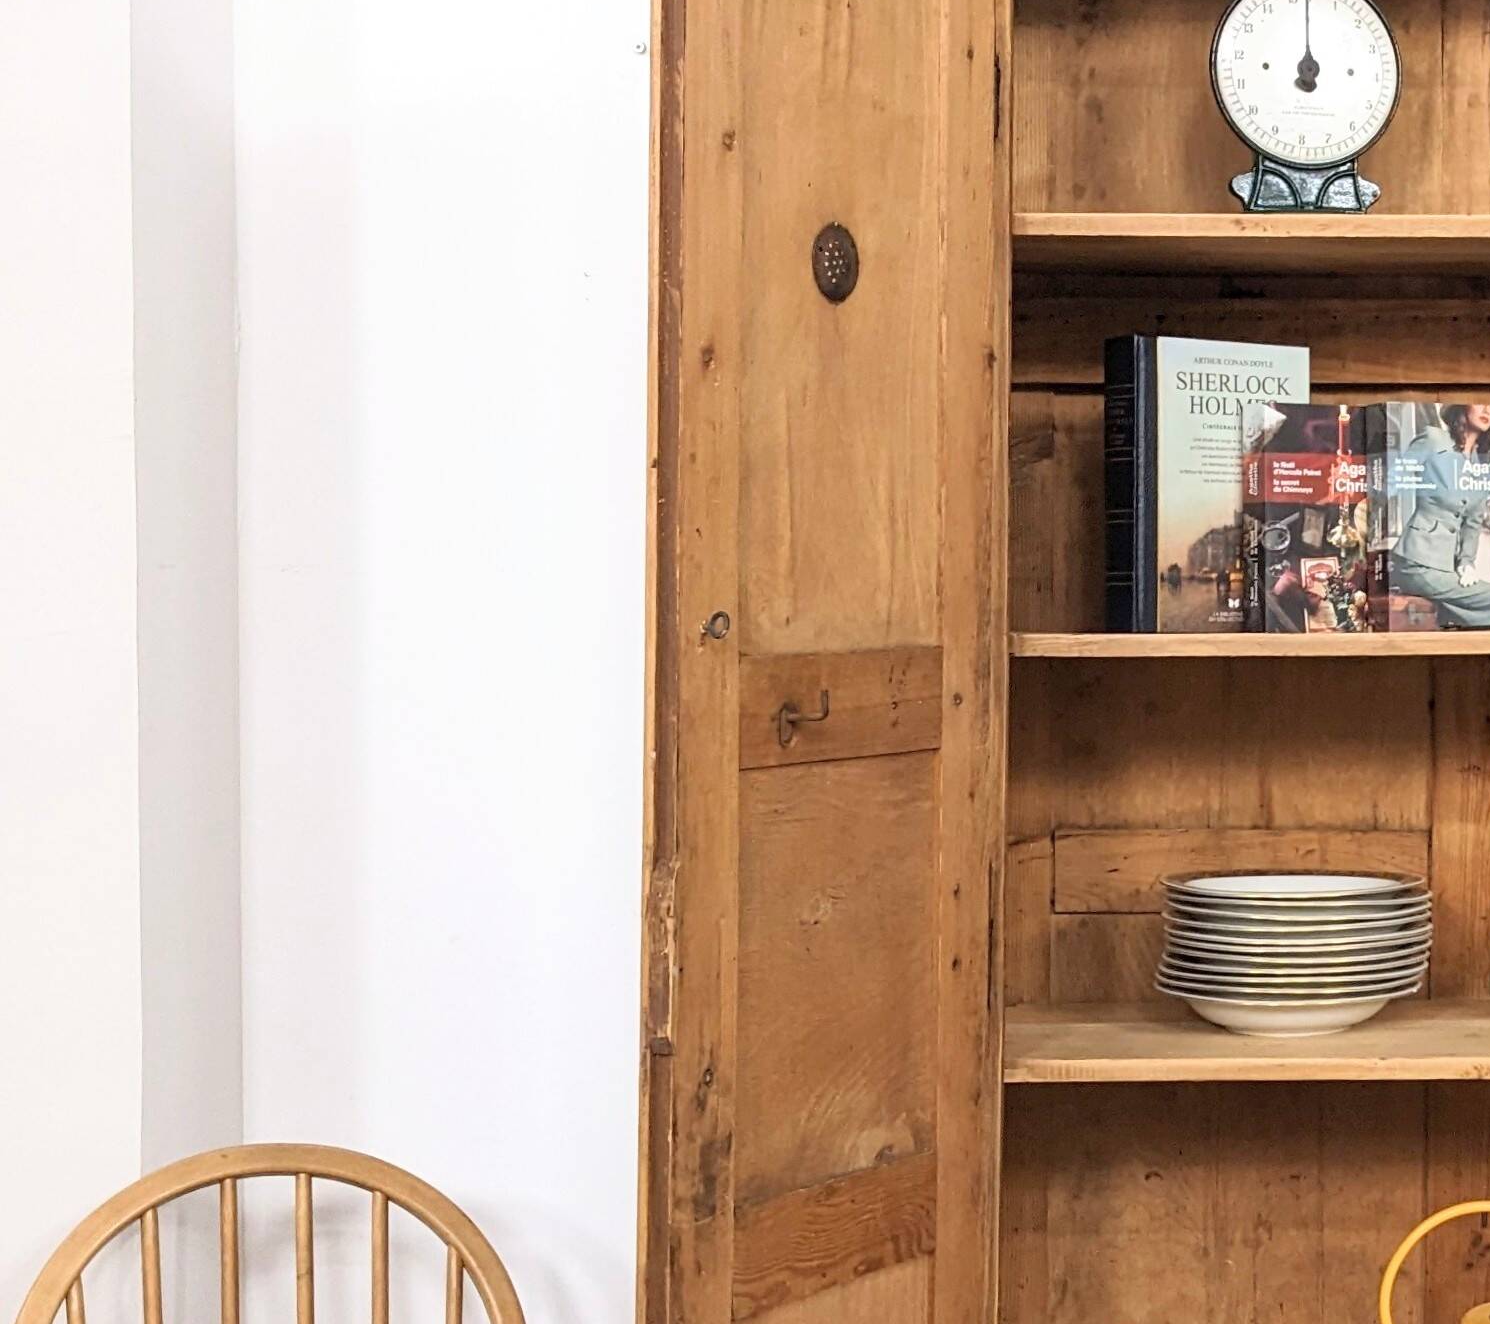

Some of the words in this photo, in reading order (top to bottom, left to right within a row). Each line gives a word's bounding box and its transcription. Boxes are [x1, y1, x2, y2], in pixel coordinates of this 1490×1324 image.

[1262, 3, 1274, 14] 14
[1243, 23, 1254, 33] 13
[1354, 18, 1362, 29] 2
[1368, 44, 1376, 54] 3
[1234, 50, 1244, 60] 12
[1248, 105, 1258, 116] 10
[1365, 100, 1373, 110] 5
[1271, 125, 1279, 136] 9
[1349, 121, 1356, 132] 6
[1298, 135, 1306, 145] 8
[1325, 133, 1332, 144] 7
[1193, 357, 1222, 365] ARTHUR
[1223, 358, 1249, 366] CONAN
[1250, 360, 1274, 368] DOYLE
[1176, 371, 1291, 396] SHERLOCK
[1189, 395, 1278, 416] HOLM
[1339, 461, 1366, 478] Aga
